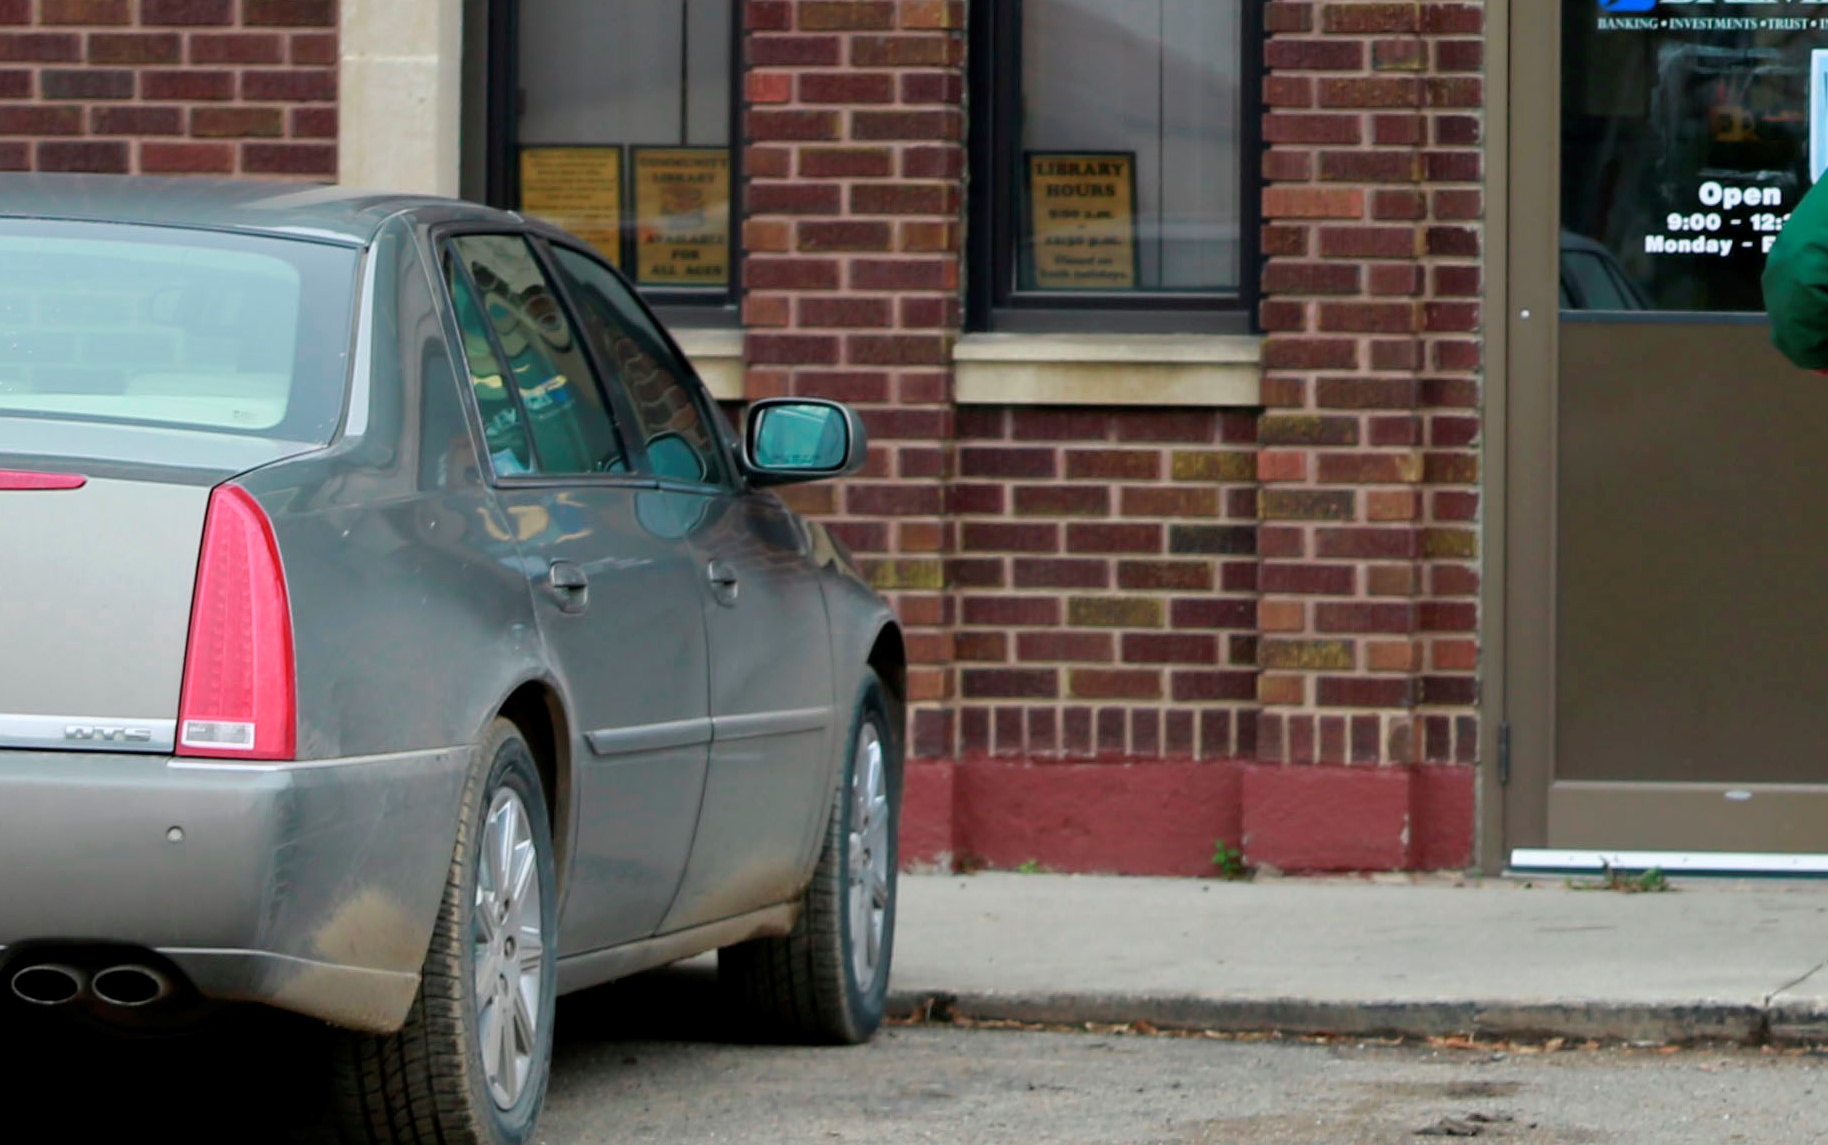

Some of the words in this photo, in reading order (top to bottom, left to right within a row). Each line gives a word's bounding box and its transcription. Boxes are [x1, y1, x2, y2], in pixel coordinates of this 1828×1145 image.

[1597, 17, 1659, 30] BANKING
[1669, 17, 1758, 30] INVESTMENTS
[1768, 17, 1809, 30] TRUST
[1036, 163, 1123, 176] LIBRARY
[1046, 184, 1116, 197] HOURS
[1698, 181, 1782, 210] Open
[1666, 212, 1722, 231] 9:00
[1644, 234, 1733, 257] Monday
